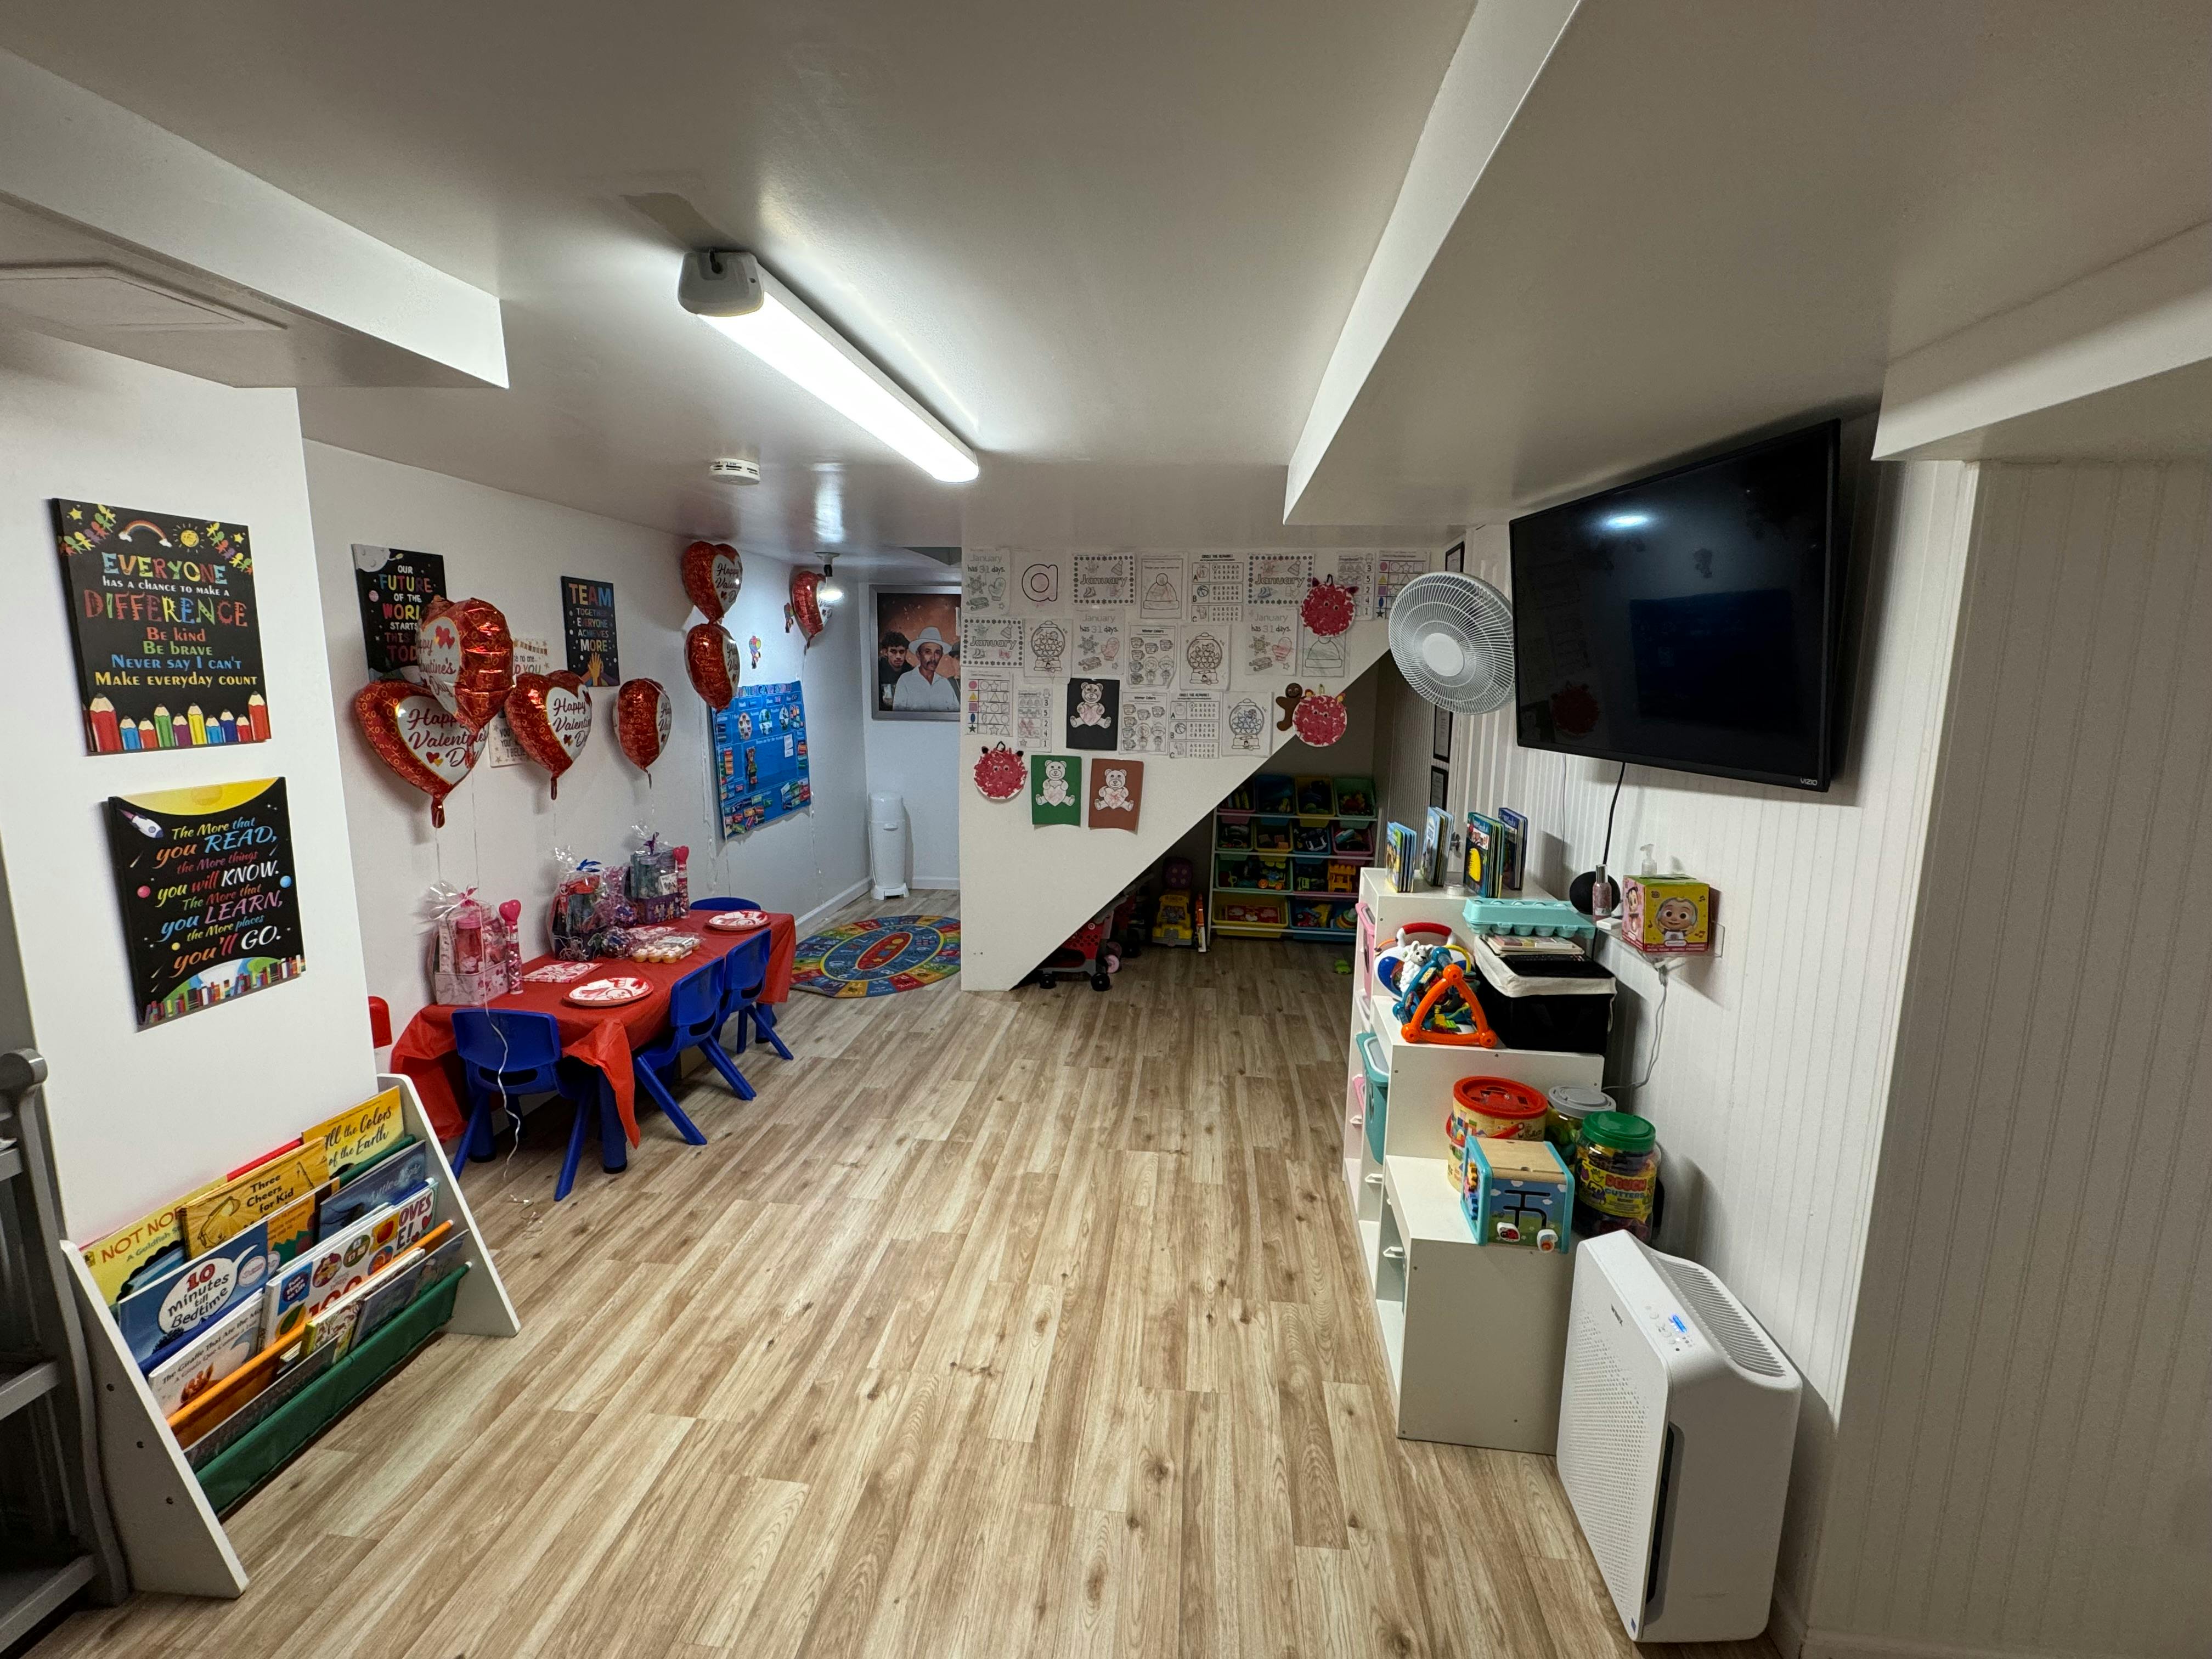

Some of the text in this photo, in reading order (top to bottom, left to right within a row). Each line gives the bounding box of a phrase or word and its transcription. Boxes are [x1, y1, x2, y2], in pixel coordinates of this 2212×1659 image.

[101, 552, 228, 585] EVERYONE
[970, 554, 1002, 563] January
[398, 565, 413, 574] OUR
[715, 562, 739, 577] Happy
[378, 574, 433, 593] FUTURE
[1080, 574, 1127, 588] January
[1255, 574, 1306, 588] January
[394, 593, 422, 603] OF THE
[568, 583, 612, 607] TEAM
[84, 589, 248, 628] DIFFERENCE
[1082, 614, 1116, 623] January
[1254, 614, 1288, 622] January
[578, 629, 609, 638] ACHIEVES
[1091, 625, 1103, 634] 31
[386, 645, 417, 662] TOD
[580, 639, 608, 652] MORE
[969, 636, 1017, 650] January
[196, 656, 202, 669] I
[523, 664, 541, 674] YOU
[553, 698, 586, 716] Happy
[407, 709, 465, 730] Happ
[1800, 777, 1818, 786] VIZIO
[172, 817, 256, 840] The More that
[152, 826, 278, 869] you READ,
[177, 850, 259, 876] the More things
[155, 860, 280, 908] you will KNOW.
[182, 884, 262, 912] The More that
[153, 889, 284, 944] you LEARN,
[187, 913, 266, 942] the More places
[168, 925, 281, 978] you'll GO.
[344, 1124, 358, 1138] the
[360, 1106, 392, 1133] Colors
[329, 1123, 390, 1167] of the Earth
[250, 1174, 281, 1193] Three
[1605, 1188, 1645, 1199] CUTTERS
[247, 1186, 283, 1207] Cheers
[259, 1187, 294, 1213] for Kid
[398, 1192, 433, 1227] OVES
[101, 1227, 143, 1263] NOT
[136, 1232, 171, 1256] Goldfish
[397, 1222, 414, 1250] E!
[186, 1263, 216, 1293] 10
[167, 1273, 230, 1317] minutes
[194, 1294, 208, 1307] till
[171, 1287, 228, 1328] Bedtime
[162, 1318, 248, 1384] The Giraffe That Ate the
